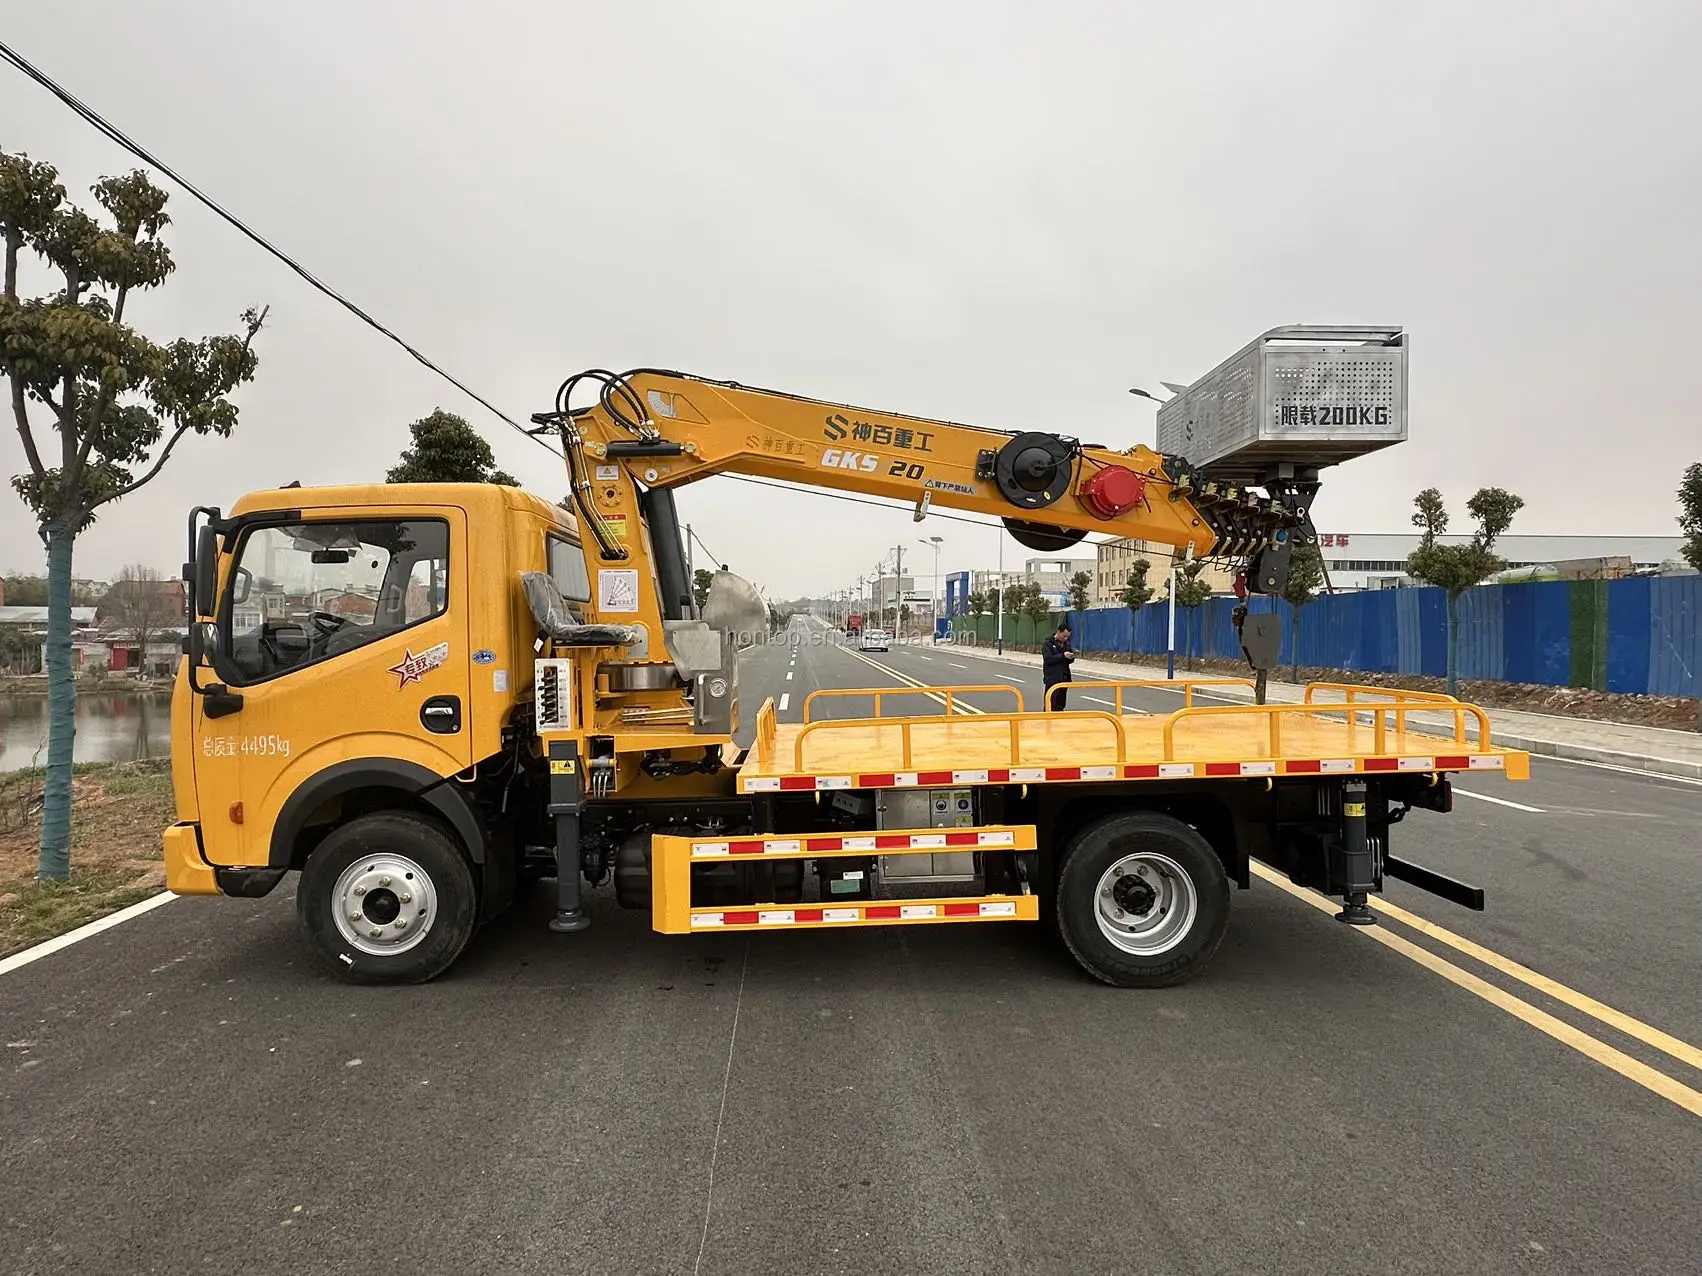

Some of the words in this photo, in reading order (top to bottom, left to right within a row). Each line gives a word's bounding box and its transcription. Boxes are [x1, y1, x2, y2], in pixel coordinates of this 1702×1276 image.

[1281, 405, 1388, 426] 限载200KG
[852, 421, 935, 452] 神百重工
[821, 449, 880, 472] GKS
[888, 461, 925, 480] 20
